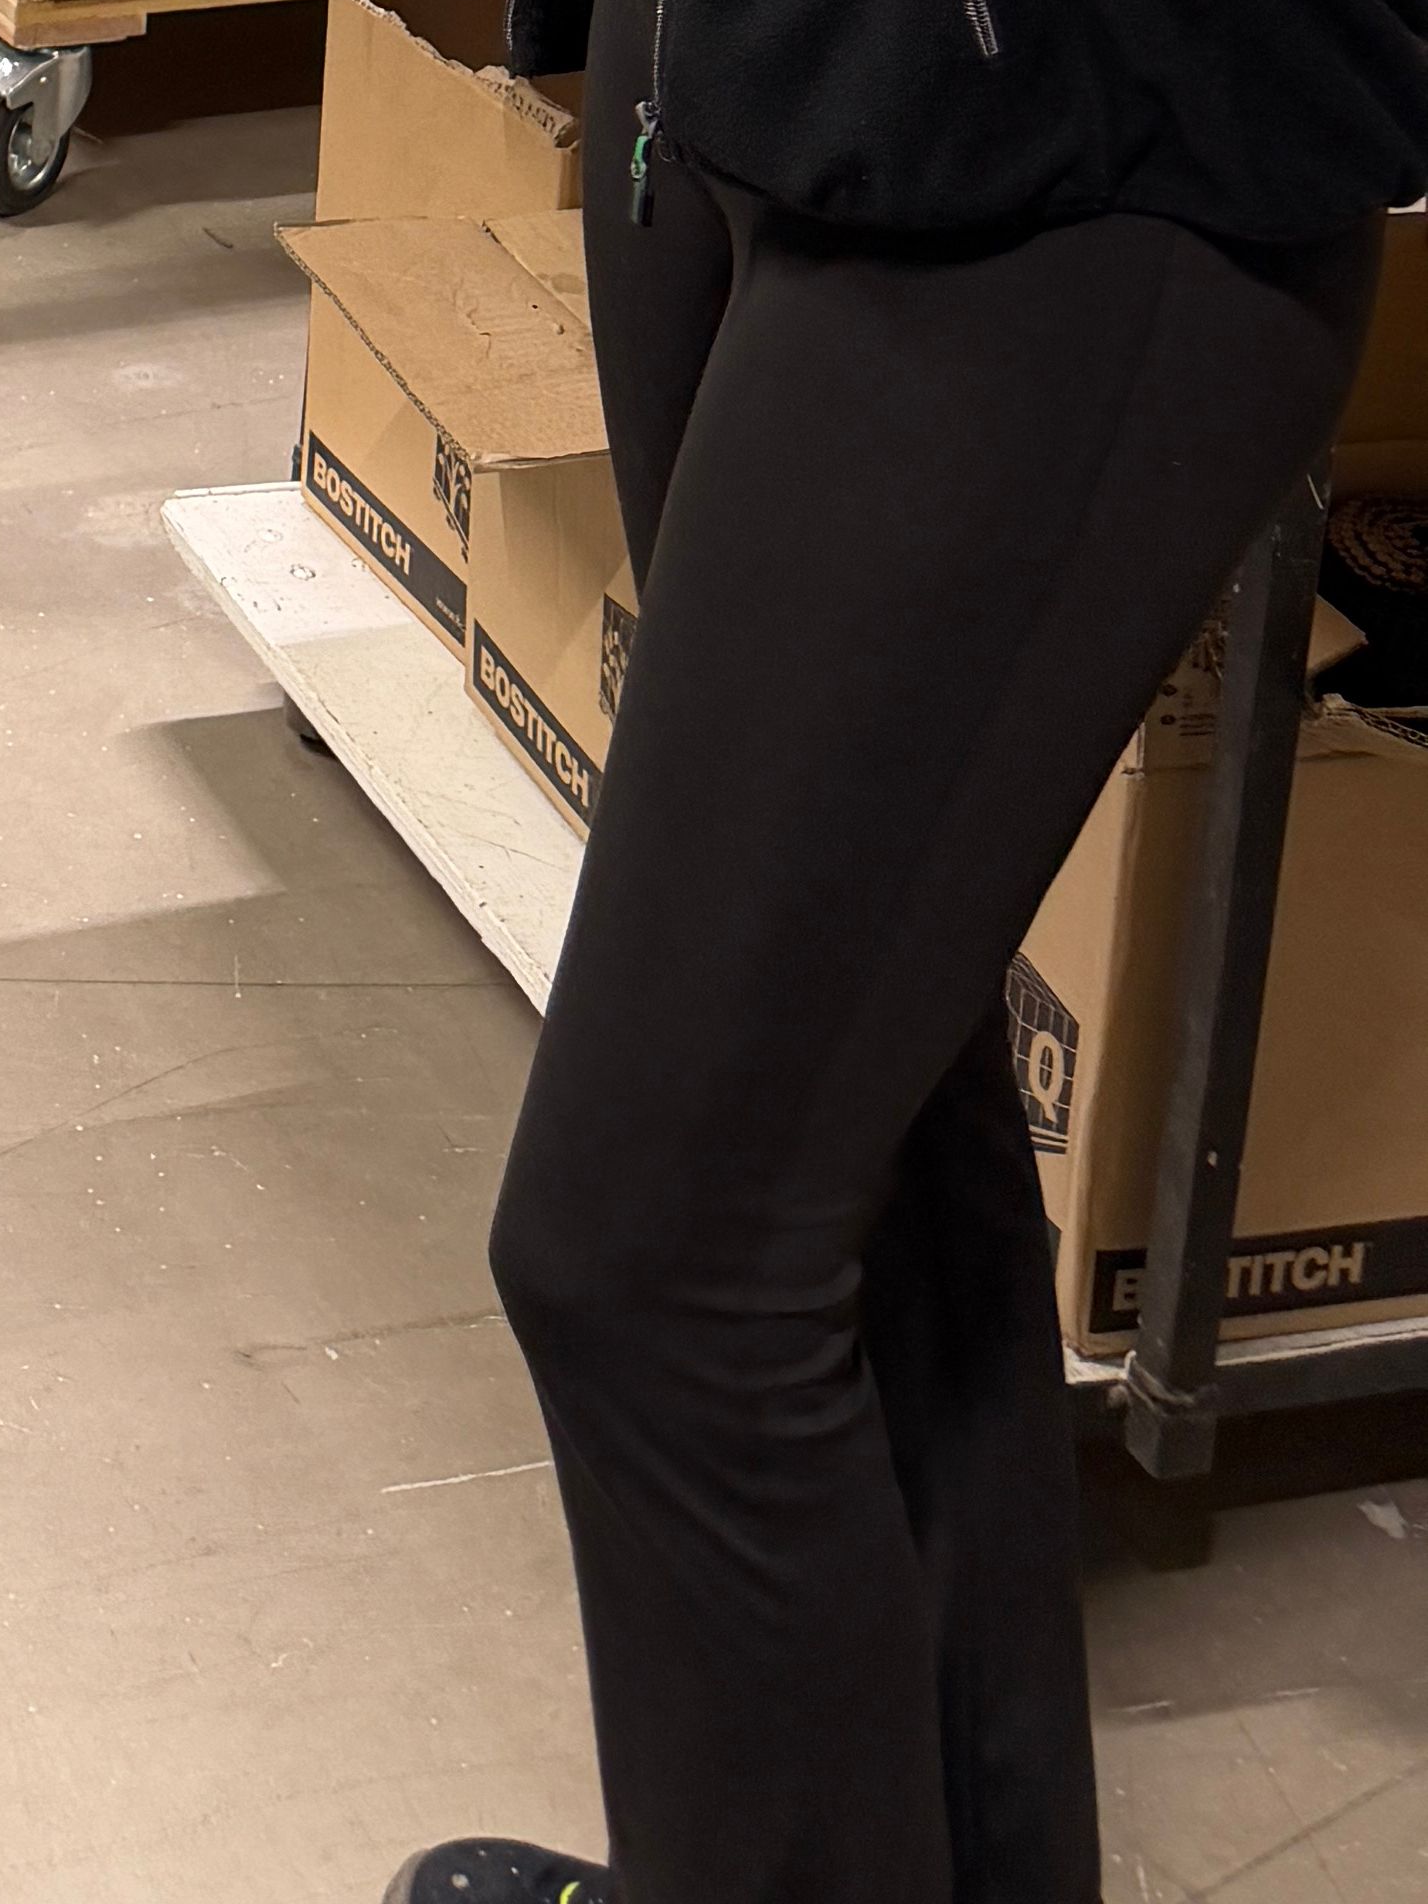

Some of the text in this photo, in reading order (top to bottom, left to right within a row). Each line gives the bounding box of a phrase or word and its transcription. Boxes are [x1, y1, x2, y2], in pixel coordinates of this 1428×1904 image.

[314, 452, 412, 576] BOSTITCH
[481, 645, 589, 807] BOSTITCH
[1115, 1241, 1365, 1311] BTITCH
